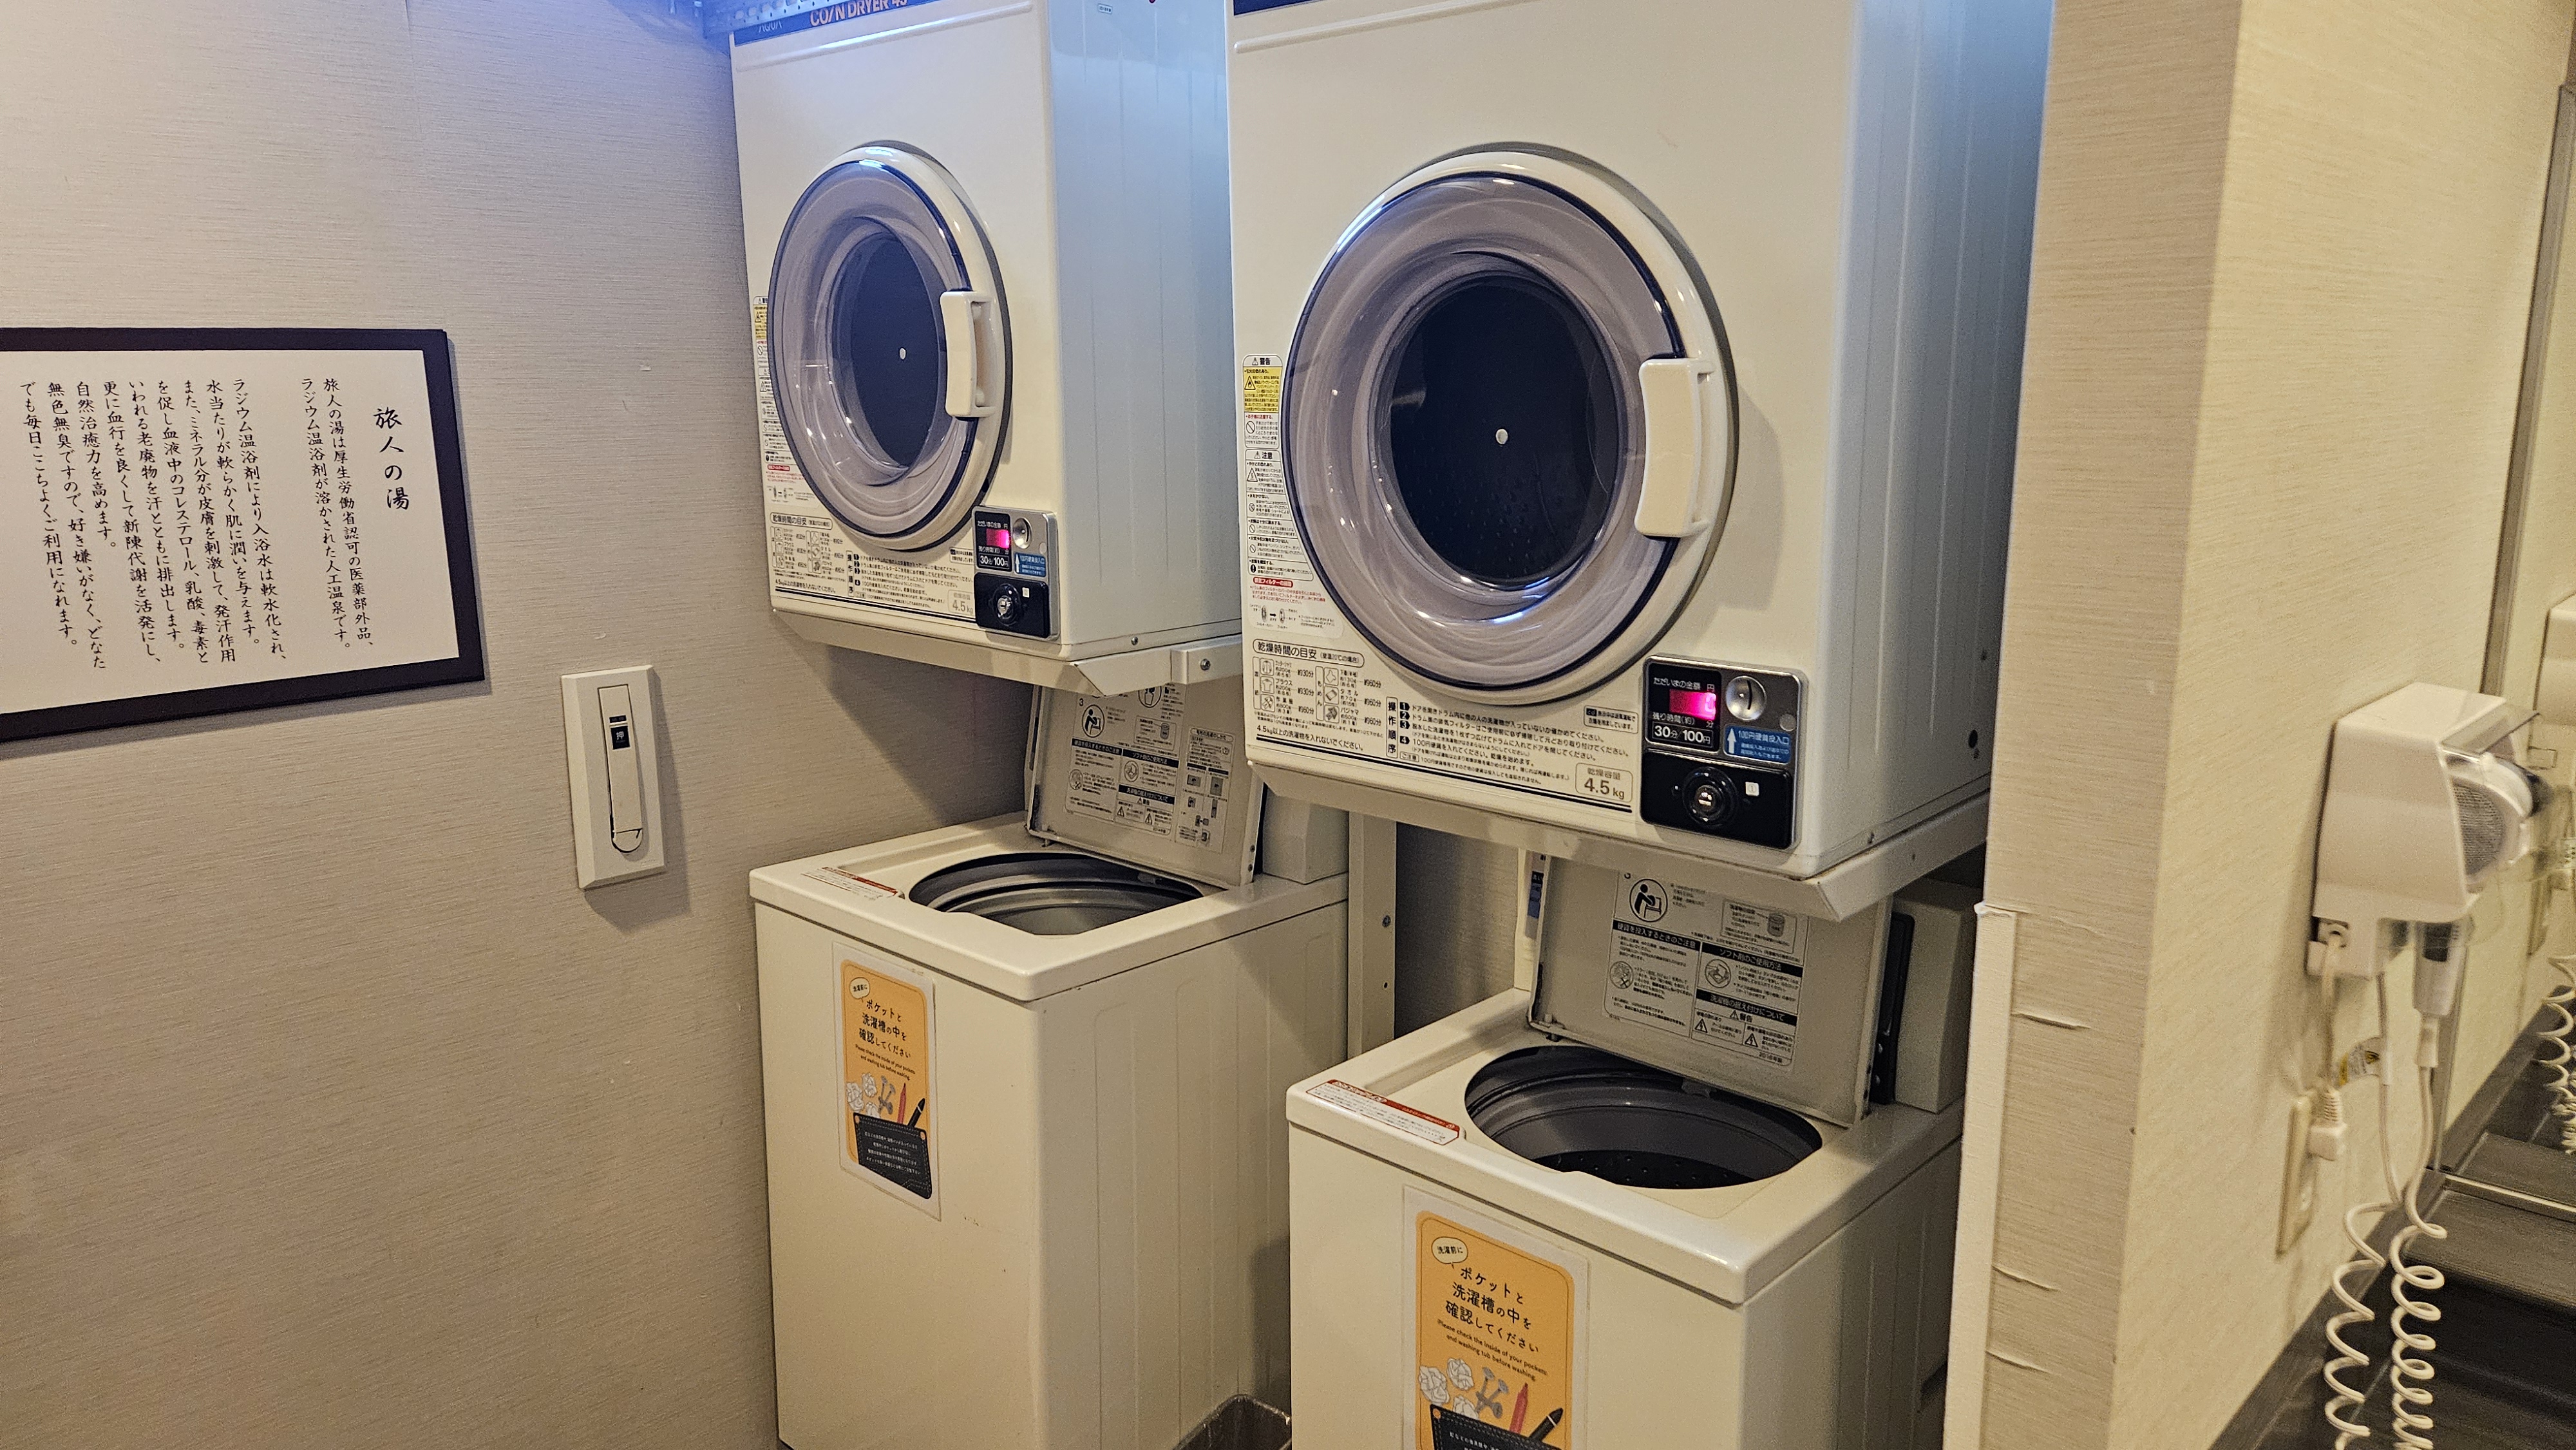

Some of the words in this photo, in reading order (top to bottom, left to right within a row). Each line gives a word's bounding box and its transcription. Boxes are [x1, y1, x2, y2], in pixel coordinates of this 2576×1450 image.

[848, 0, 889, 18] DRYER
[758, 21, 782, 32] AQUA
[77, 381, 116, 547] 自然治癒力を高めます。
[373, 408, 410, 511] 旅人の湯
[21, 381, 78, 646] でも毎日ここちよくご利用になれます。
[46, 381, 106, 670] 無色無臭ですので、好き嫌いがなく、どなた
[103, 381, 160, 663] 更に血行を良くして新陳代謝を活発にし、
[129, 380, 185, 649] いわれる老廃物を汗とともに排出します。
[158, 381, 209, 664] を促し血液中のコレステロール、乳酸、毒素と
[184, 380, 236, 663] また、ミネラル分が皮膚を刺激して、発汗作用
[207, 380, 260, 645] 水当たりが軟らかく肌に潤いを与えます。
[233, 379, 287, 661] ラジウム温浴剤により入浴水は軟水化され、
[301, 379, 350, 649] ラジウム温浴剤が溶かされた人工温泉です。
[323, 379, 374, 647] 旅人の湯は厚生労働省認可の医薬部外品、
[773, 514, 807, 525] 乾燥時間の目安
[952, 599, 965, 612] 4.5
[1258, 641, 1316, 659] 乾燥時間の目安
[1653, 677, 1701, 690] ただいまの金額
[1707, 684, 1714, 692] 円
[1079, 698, 1084, 706] 3
[616, 731, 625, 740] 押
[1257, 724, 1363, 751] 4.5kg以上の洗濯物を入れないでください。
[1388, 701, 1396, 753] 操作順序
[1654, 726, 1711, 745] 30分/100円
[1706, 720, 1714, 728] 分
[1587, 767, 1621, 780] 乾燥容量
[1584, 777, 1609, 795] 4.5
[1613, 787, 1625, 800] kg
[1617, 922, 1696, 949] 硬貨を投入するときのご注意
[1719, 948, 1782, 971] ソフト剤のご使用方法
[866, 999, 902, 1022] ポケットと
[1710, 994, 1785, 1021] 洗濯機の据え付けについて
[862, 1012, 907, 1041] 洗濯槽の中を
[859, 1028, 911, 1058] 確認してください
[1437, 1245, 1463, 1255] 洗濯前に
[1460, 1266, 1523, 1304] ポケットと
[1453, 1281, 1531, 1330] 洗濯槽の中を
[1445, 1300, 1539, 1353] 確認してください
[1437, 1319, 1455, 1332] Please
[1456, 1328, 1473, 1341] check
[1473, 1337, 1482, 1346] the
[1484, 1341, 1501, 1353] inside
[1509, 1353, 1522, 1364] your
[1446, 1334, 1457, 1343] and
[1458, 1340, 1480, 1355] washing
[1481, 1350, 1491, 1359] tub
[1492, 1355, 1511, 1369] before
